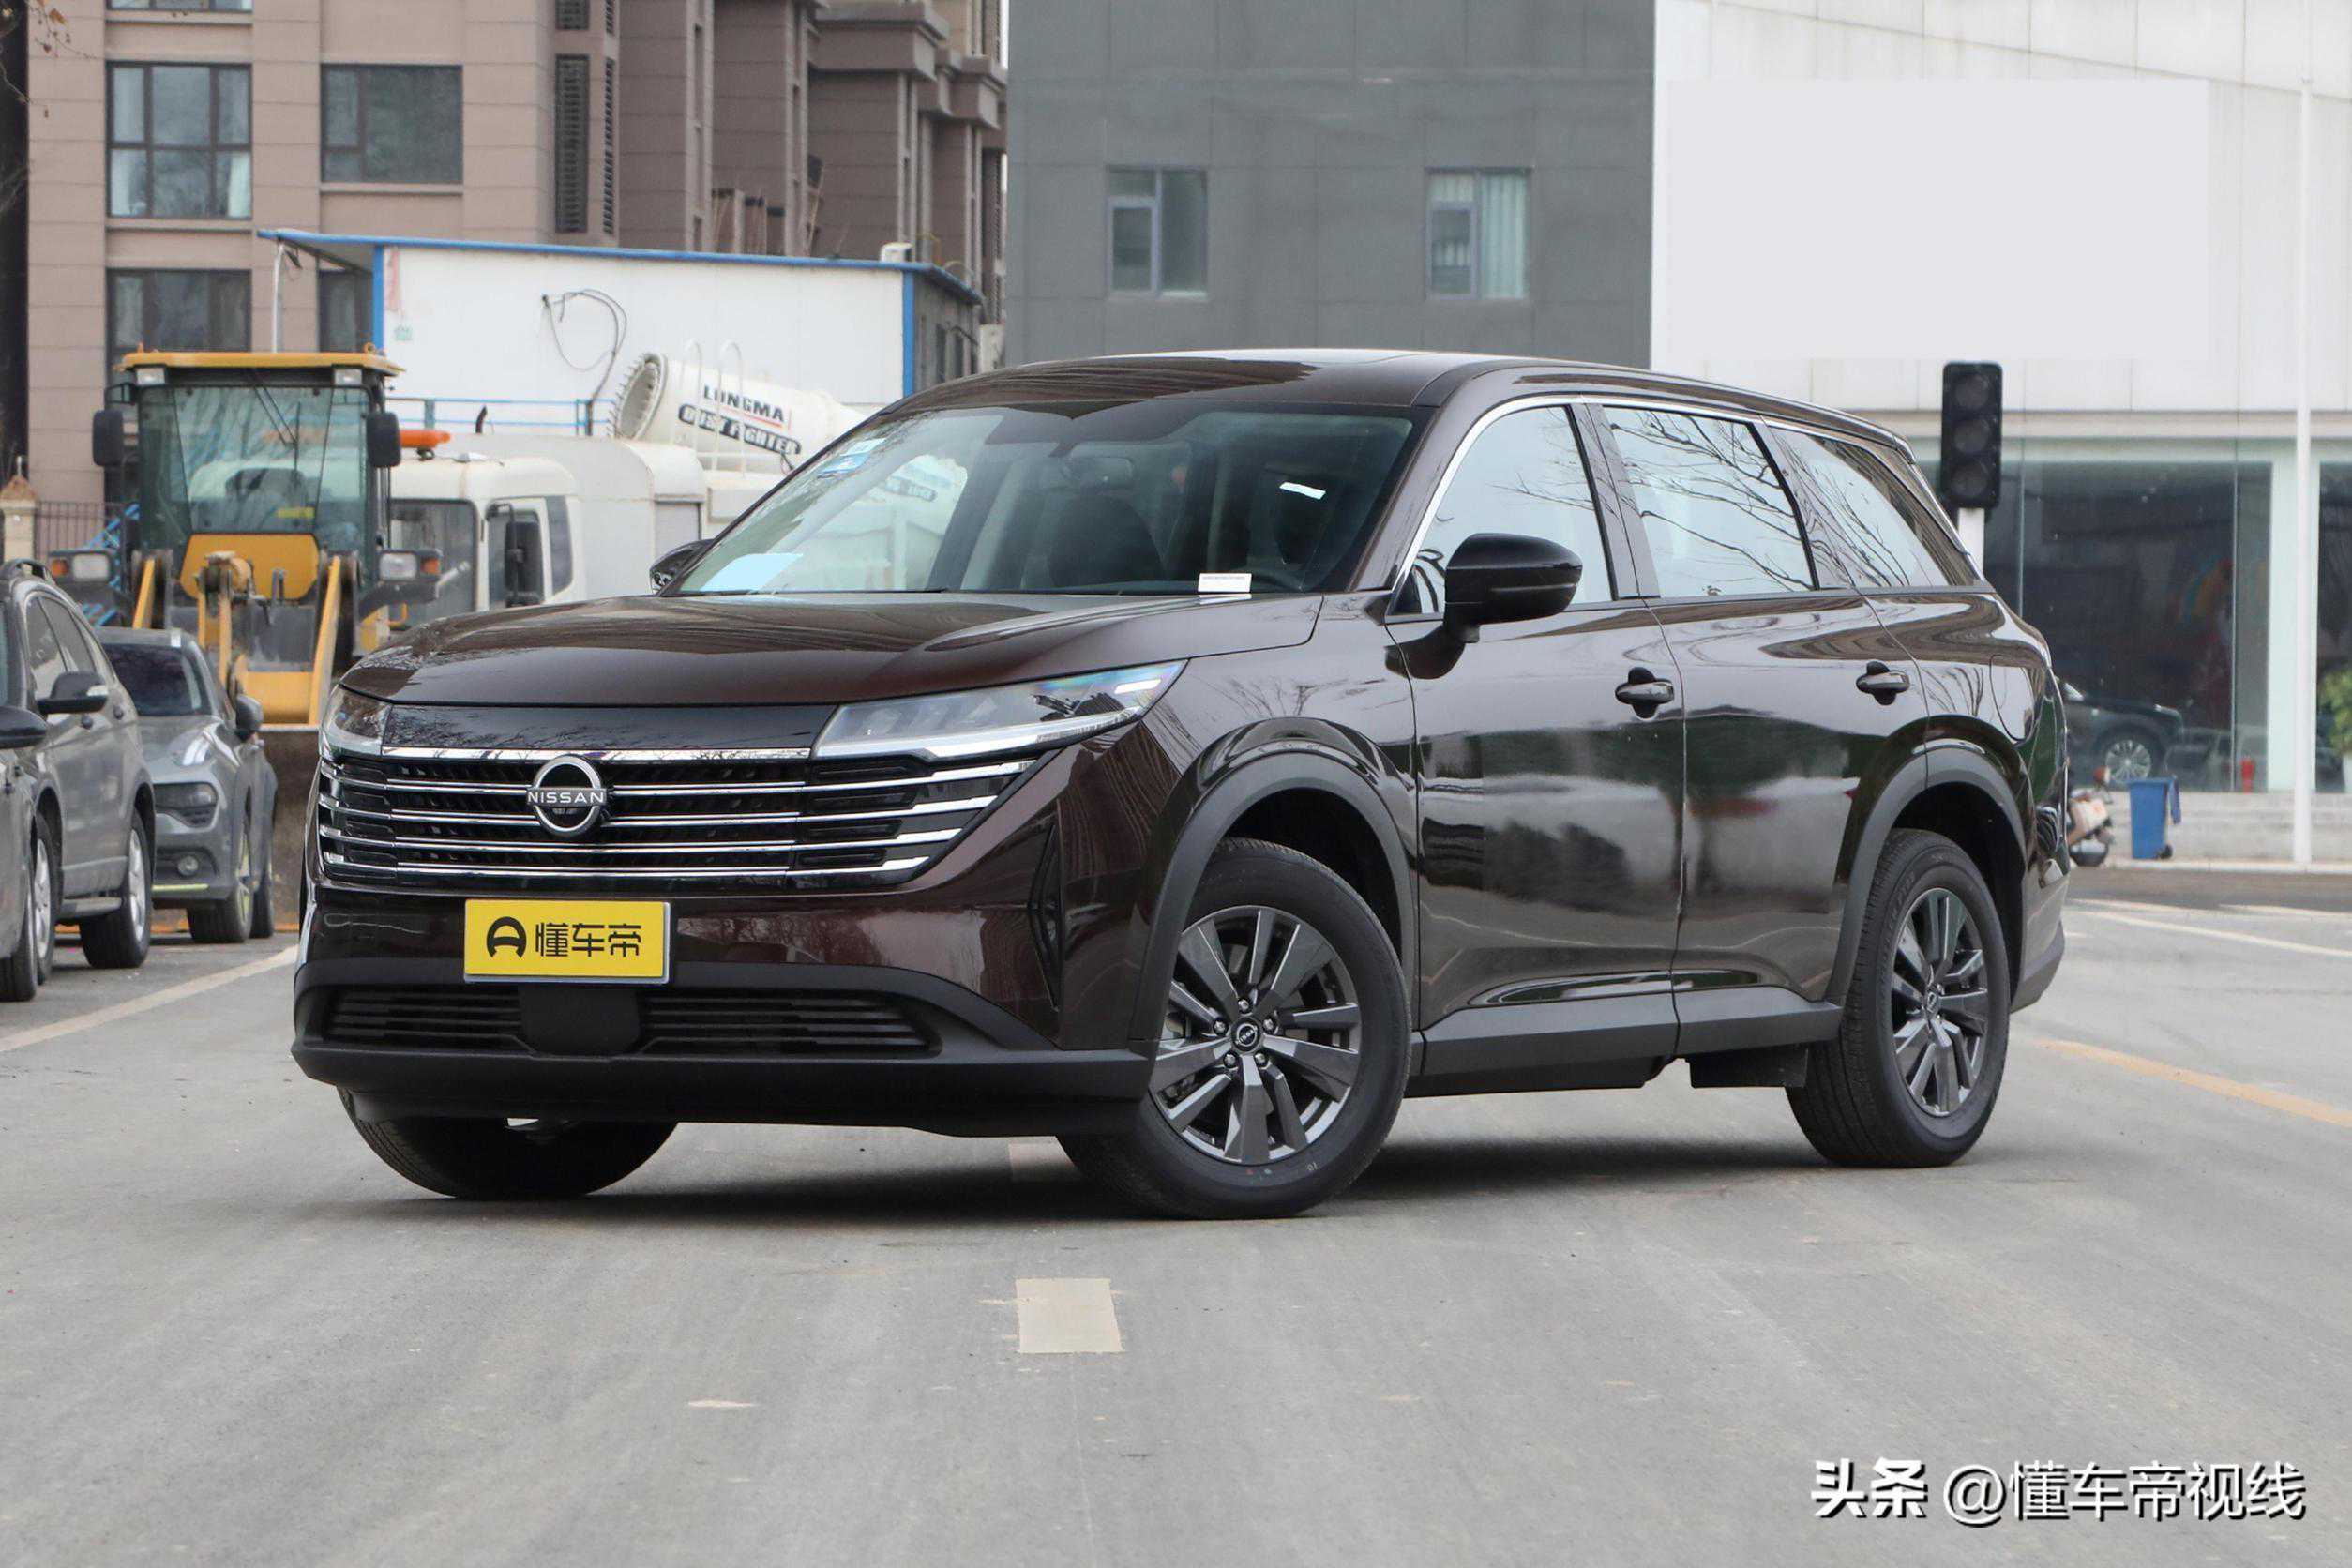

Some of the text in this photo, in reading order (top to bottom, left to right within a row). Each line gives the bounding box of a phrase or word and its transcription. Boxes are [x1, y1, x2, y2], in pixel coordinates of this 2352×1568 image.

[527, 790, 605, 804] NISSAN
[535, 921, 642, 957] 懂车帝
